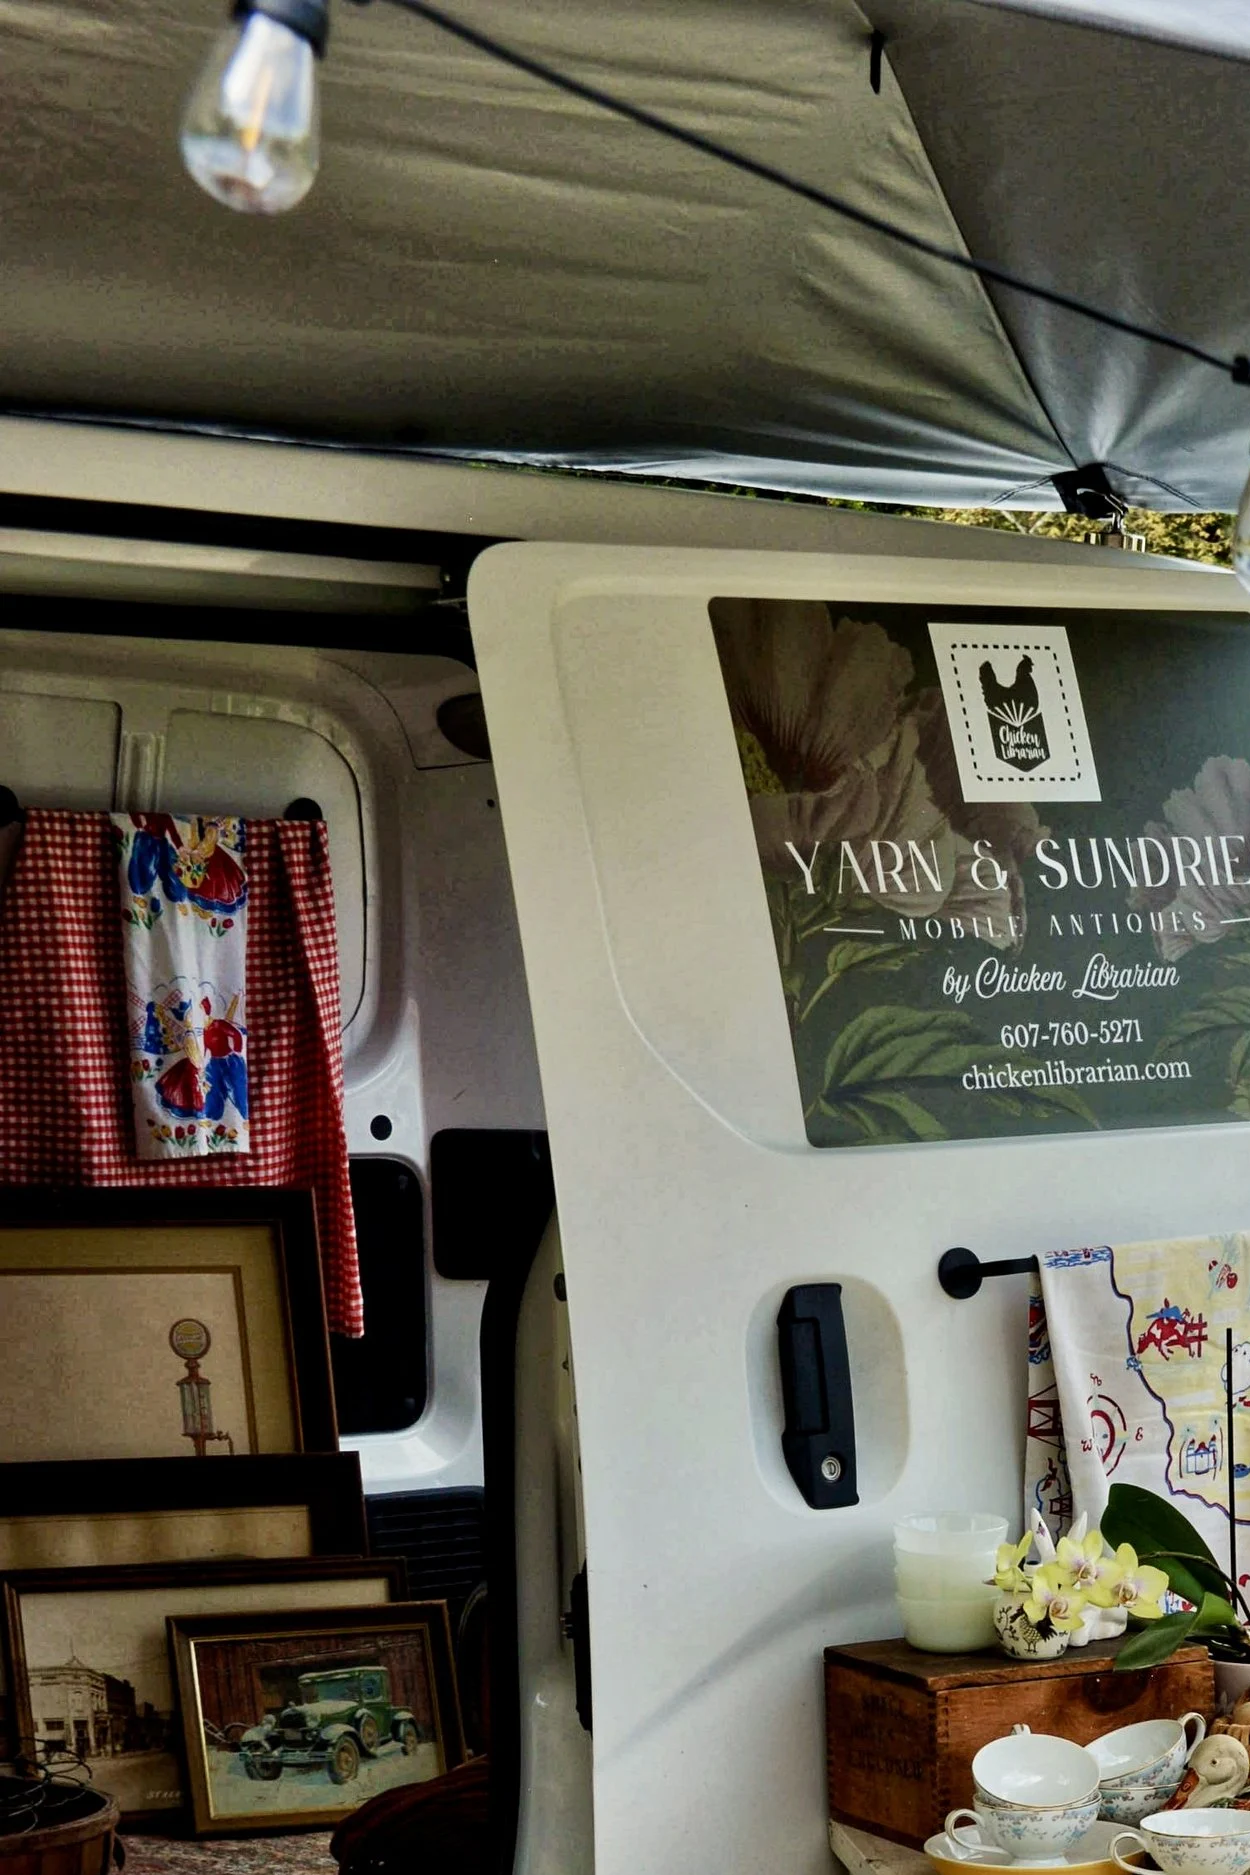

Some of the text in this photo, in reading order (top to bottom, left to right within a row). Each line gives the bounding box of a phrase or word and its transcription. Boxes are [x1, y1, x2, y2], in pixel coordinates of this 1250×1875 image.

[1000, 725, 1040, 748] Chicken
[1001, 745, 1046, 760] Librarian
[785, 840, 943, 895] YARN
[971, 839, 1008, 891] &
[899, 911, 1206, 941] MOBILE ANTIQUES
[943, 953, 1180, 1003] by Chicken Librarian
[1001, 1019, 1144, 1049] 607-760-5271
[962, 1059, 1191, 1092] chickenlibrarian.com
